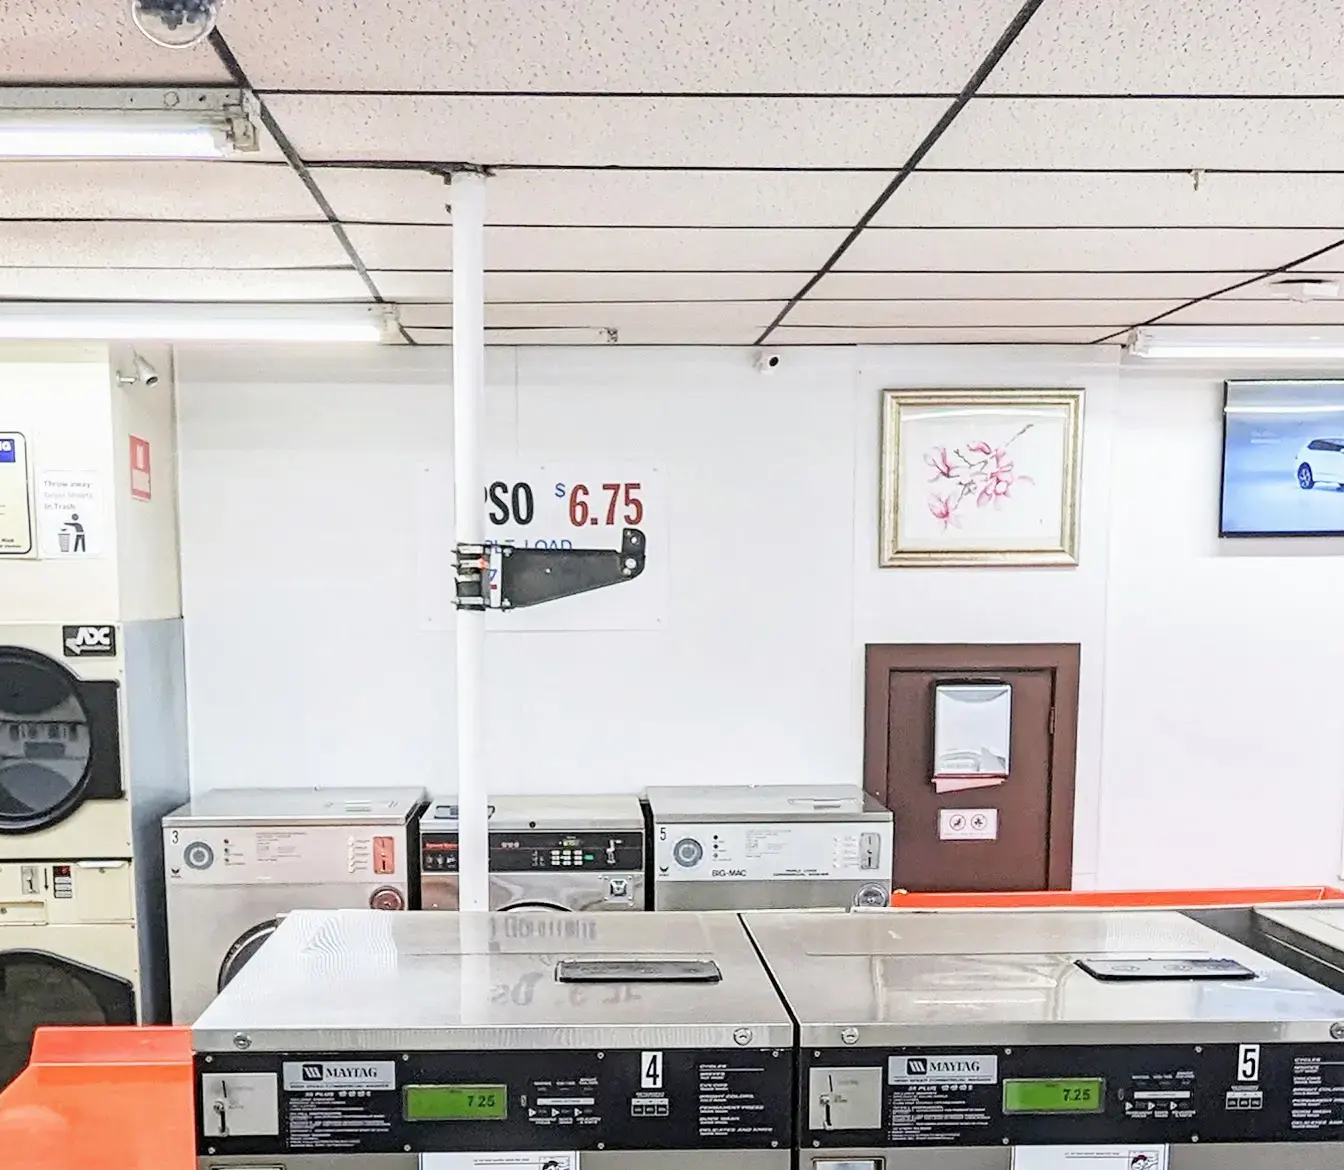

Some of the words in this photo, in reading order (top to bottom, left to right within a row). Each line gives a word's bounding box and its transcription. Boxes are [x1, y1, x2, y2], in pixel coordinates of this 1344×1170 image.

[484, 481, 534, 525] SO
[75, 626, 111, 646] ADC
[172, 830, 179, 844] 3
[660, 827, 667, 841] 5
[711, 869, 747, 878] BIG-MAC
[645, 1054, 660, 1086] 4
[929, 1061, 980, 1072] MAYTAG
[1241, 1048, 1256, 1079] 5
[325, 1067, 377, 1078] MAYTAG
